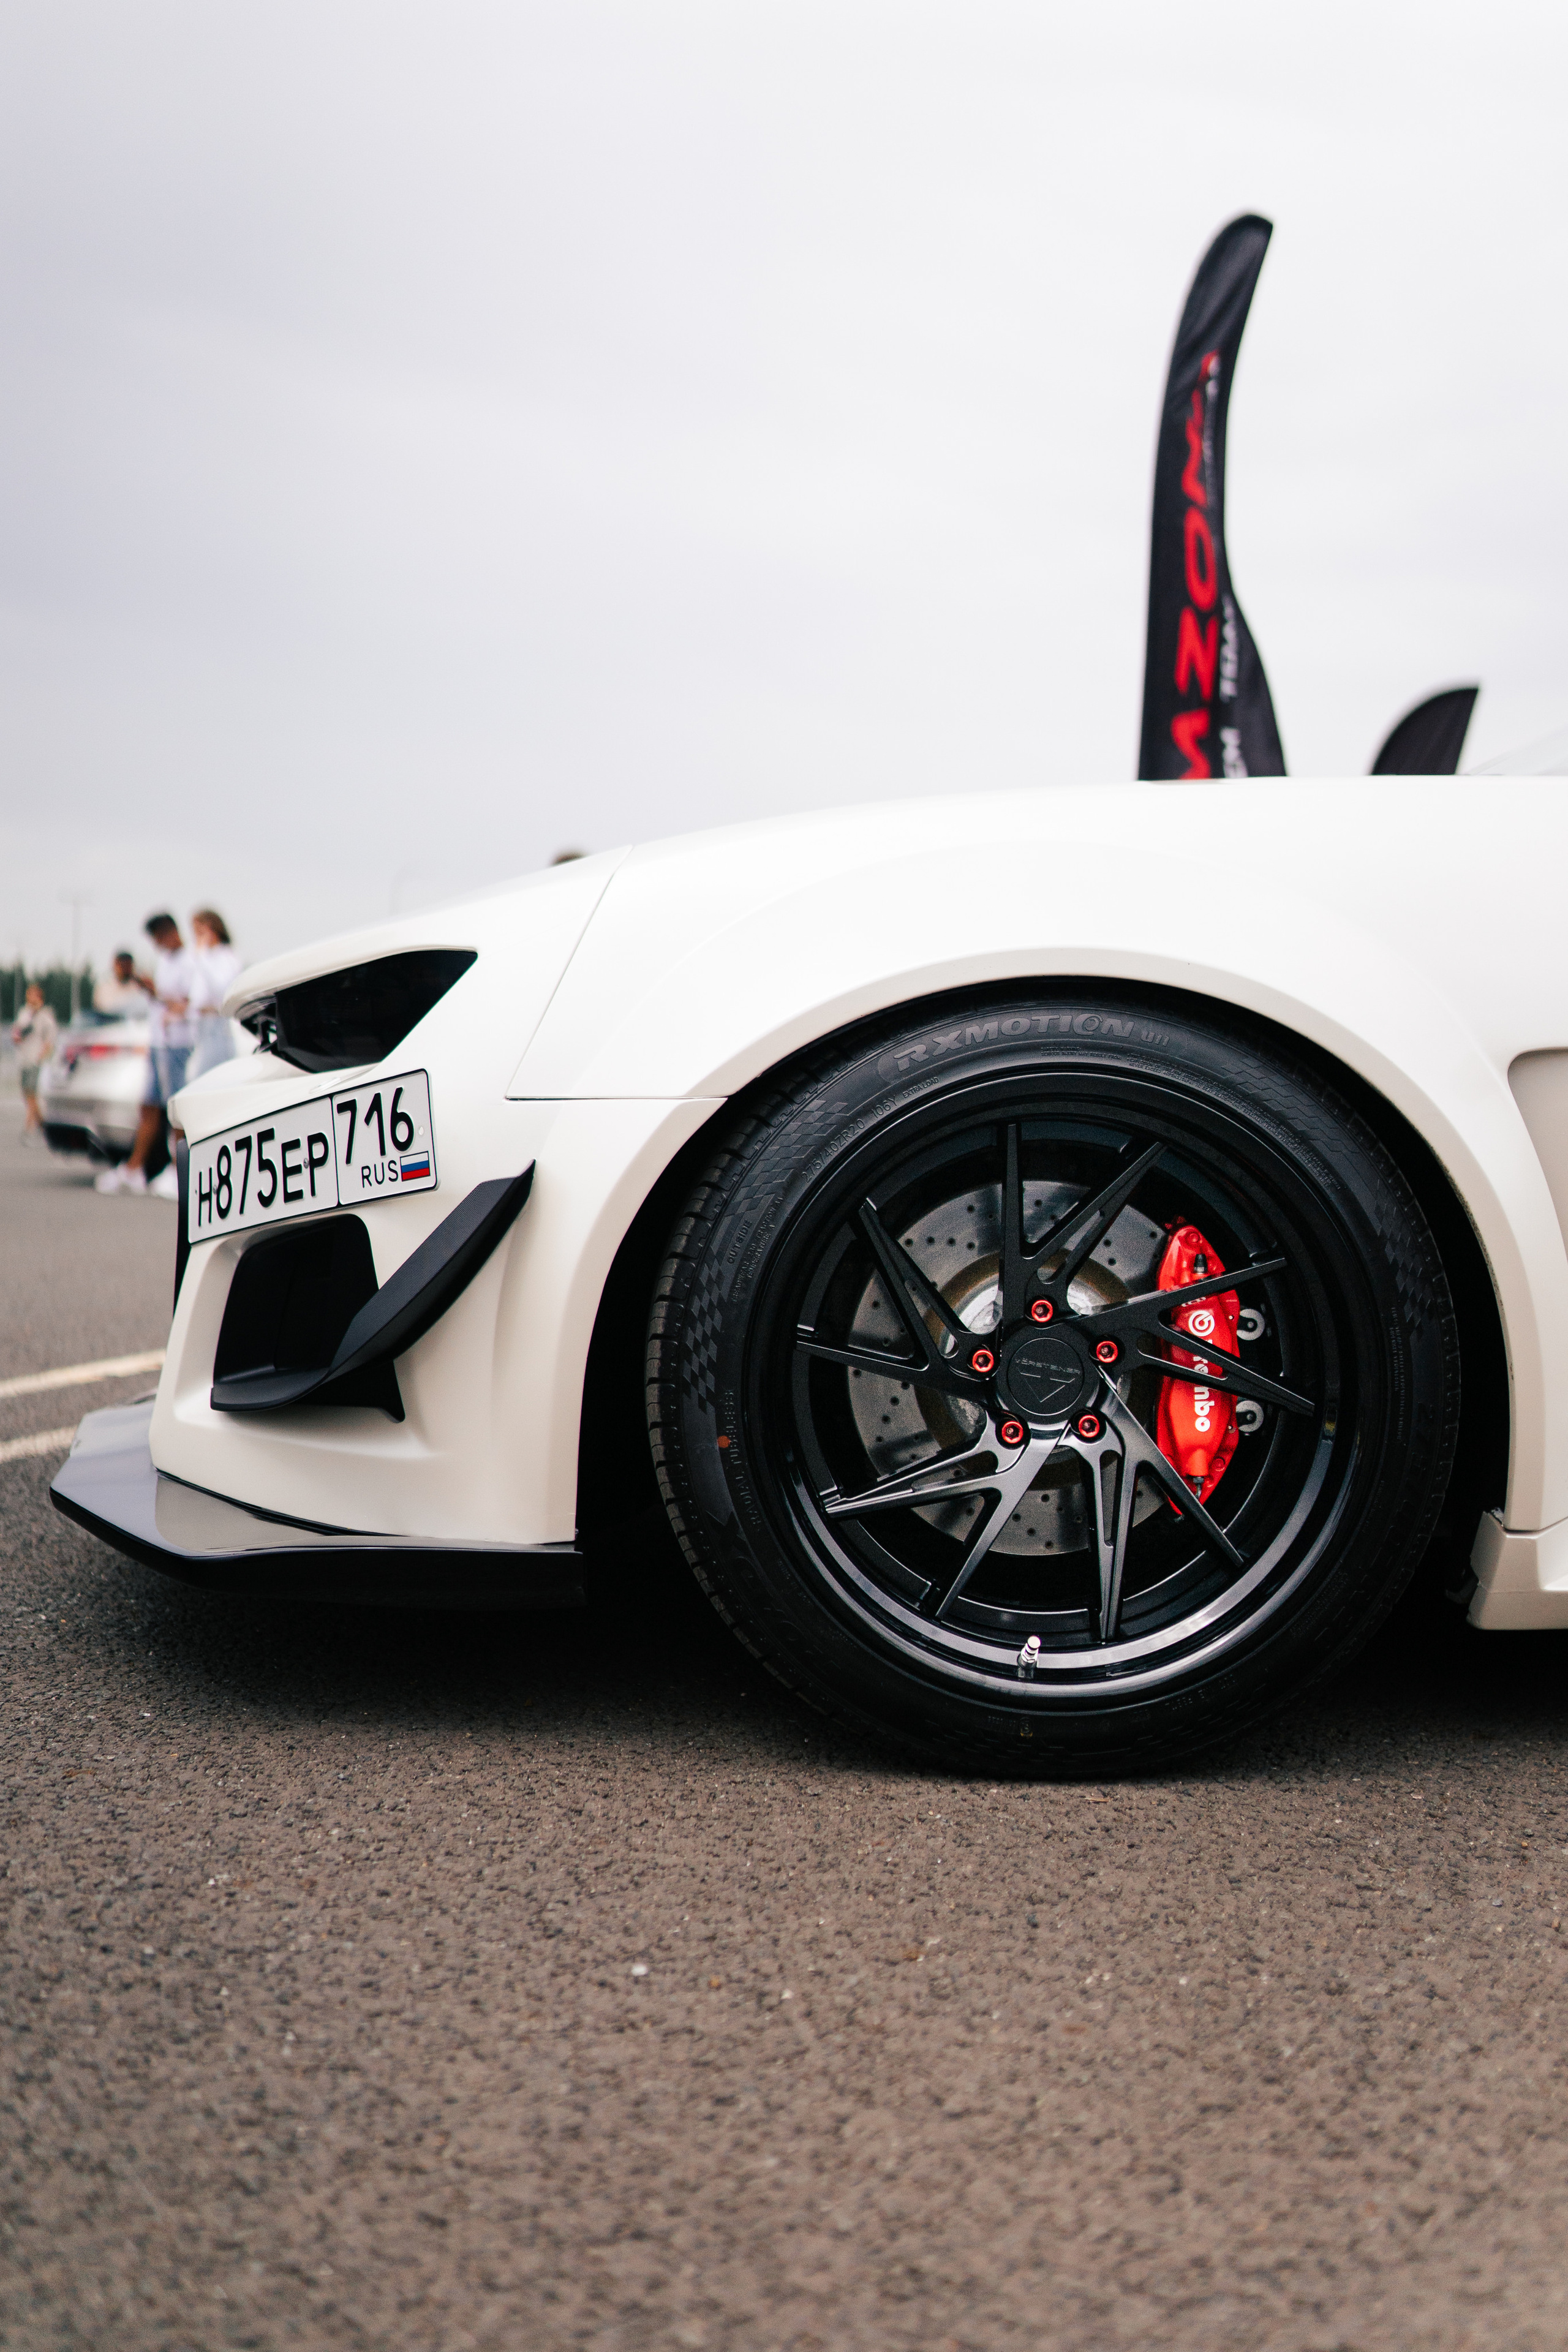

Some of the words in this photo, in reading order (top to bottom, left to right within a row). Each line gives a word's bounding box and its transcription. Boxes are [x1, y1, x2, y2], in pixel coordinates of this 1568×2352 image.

[894, 1013, 1135, 1072] RXMOTION
[336, 1087, 415, 1165] 716
[801, 1118, 865, 1183] 275/40ZR20
[870, 1095, 899, 1119] 106Y
[902, 1085, 924, 1099] EXTRA
[922, 1076, 940, 1090] LOAD
[361, 1159, 399, 1189] RUS
[726, 1219, 753, 1265] OUTSIDE
[1193, 1339, 1215, 1433] rembo
